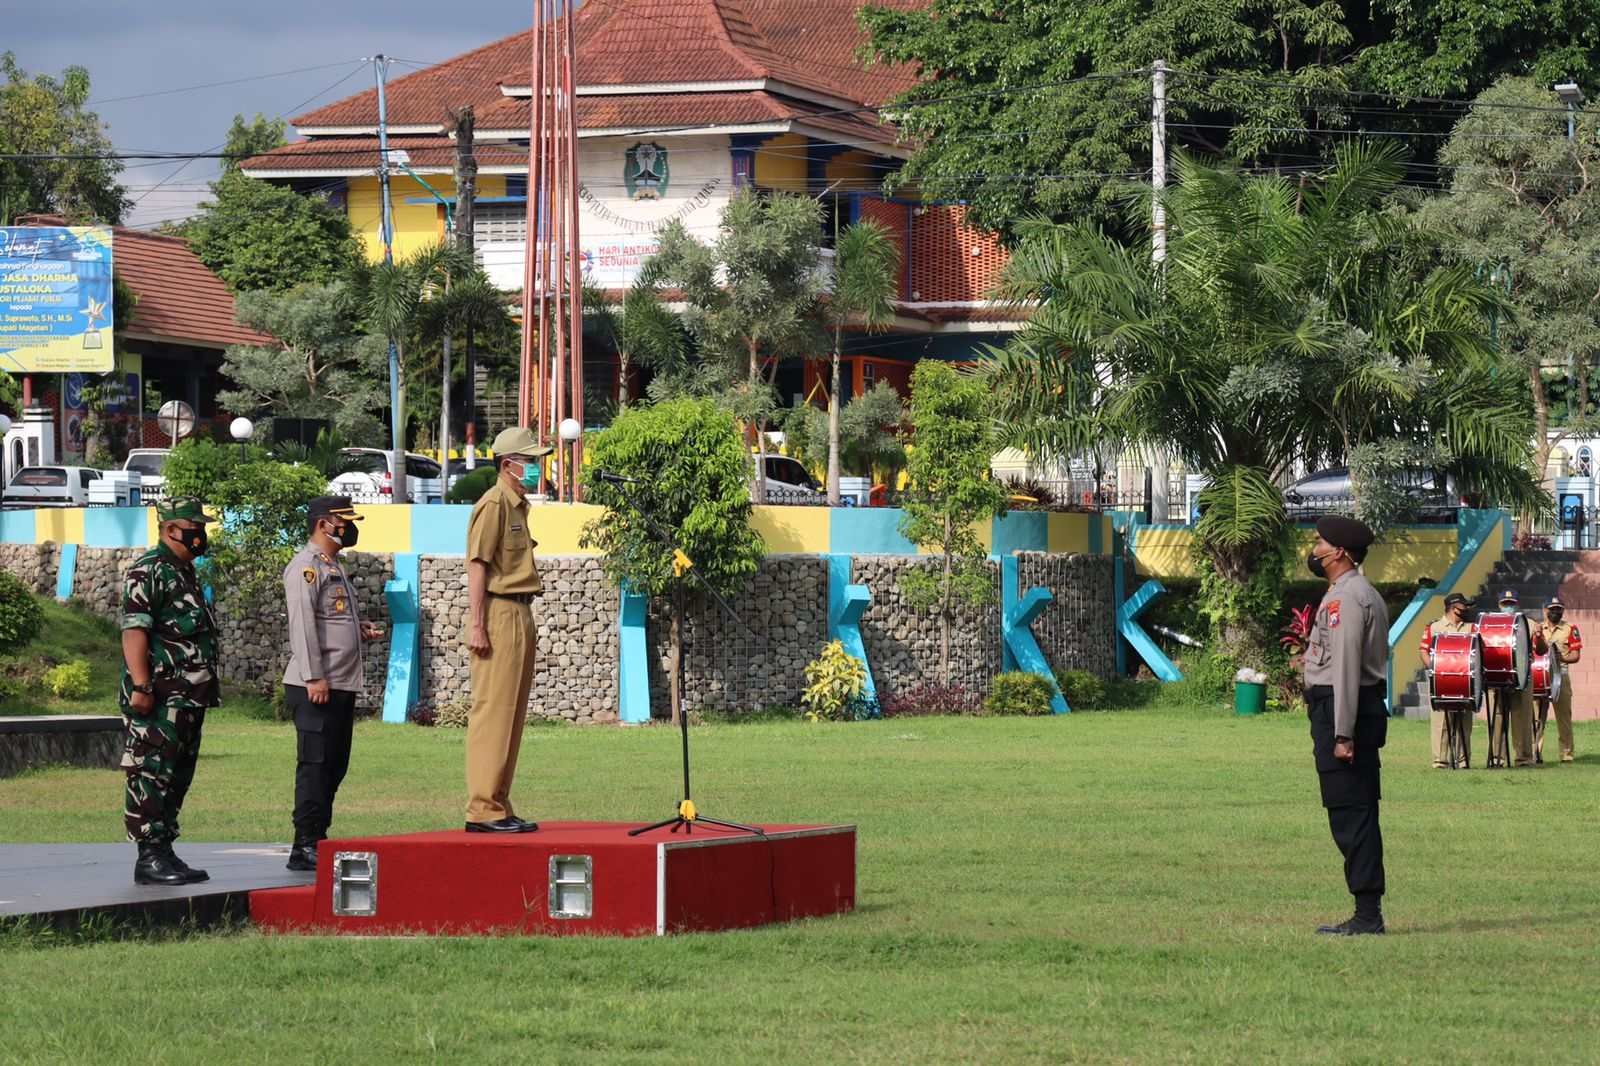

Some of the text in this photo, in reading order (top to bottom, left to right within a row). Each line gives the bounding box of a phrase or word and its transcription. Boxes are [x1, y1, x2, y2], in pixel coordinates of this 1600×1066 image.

[599, 246, 620, 255] HARI
[2, 273, 79, 282] JASA DHARMA
